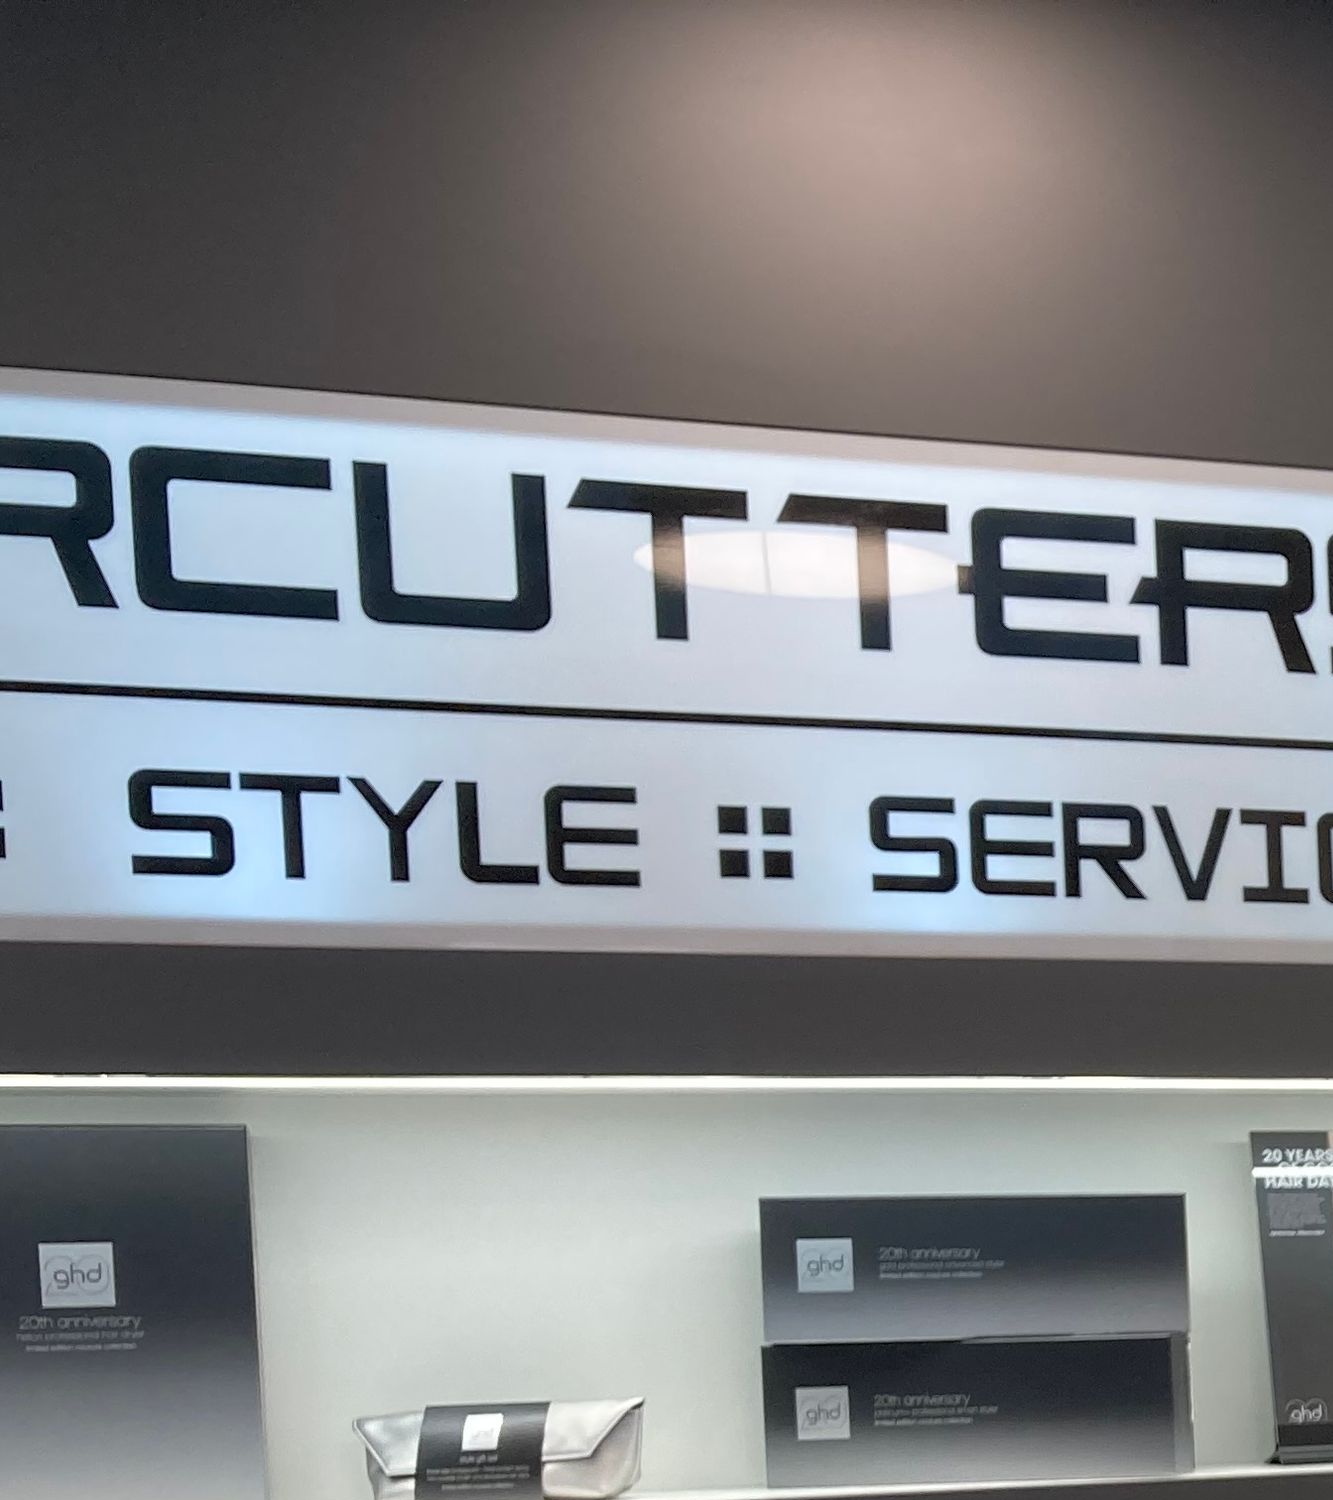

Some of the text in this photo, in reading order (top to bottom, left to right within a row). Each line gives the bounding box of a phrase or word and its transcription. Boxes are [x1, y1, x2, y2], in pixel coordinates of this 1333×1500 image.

[127, 769, 642, 888] STYLE
[1261, 1148, 1283, 1163] 20
[53, 1262, 102, 1290] ghd
[806, 1253, 845, 1277] ghd
[18, 1314, 142, 1330] 20th anniversary
[806, 1401, 841, 1426] ghd
